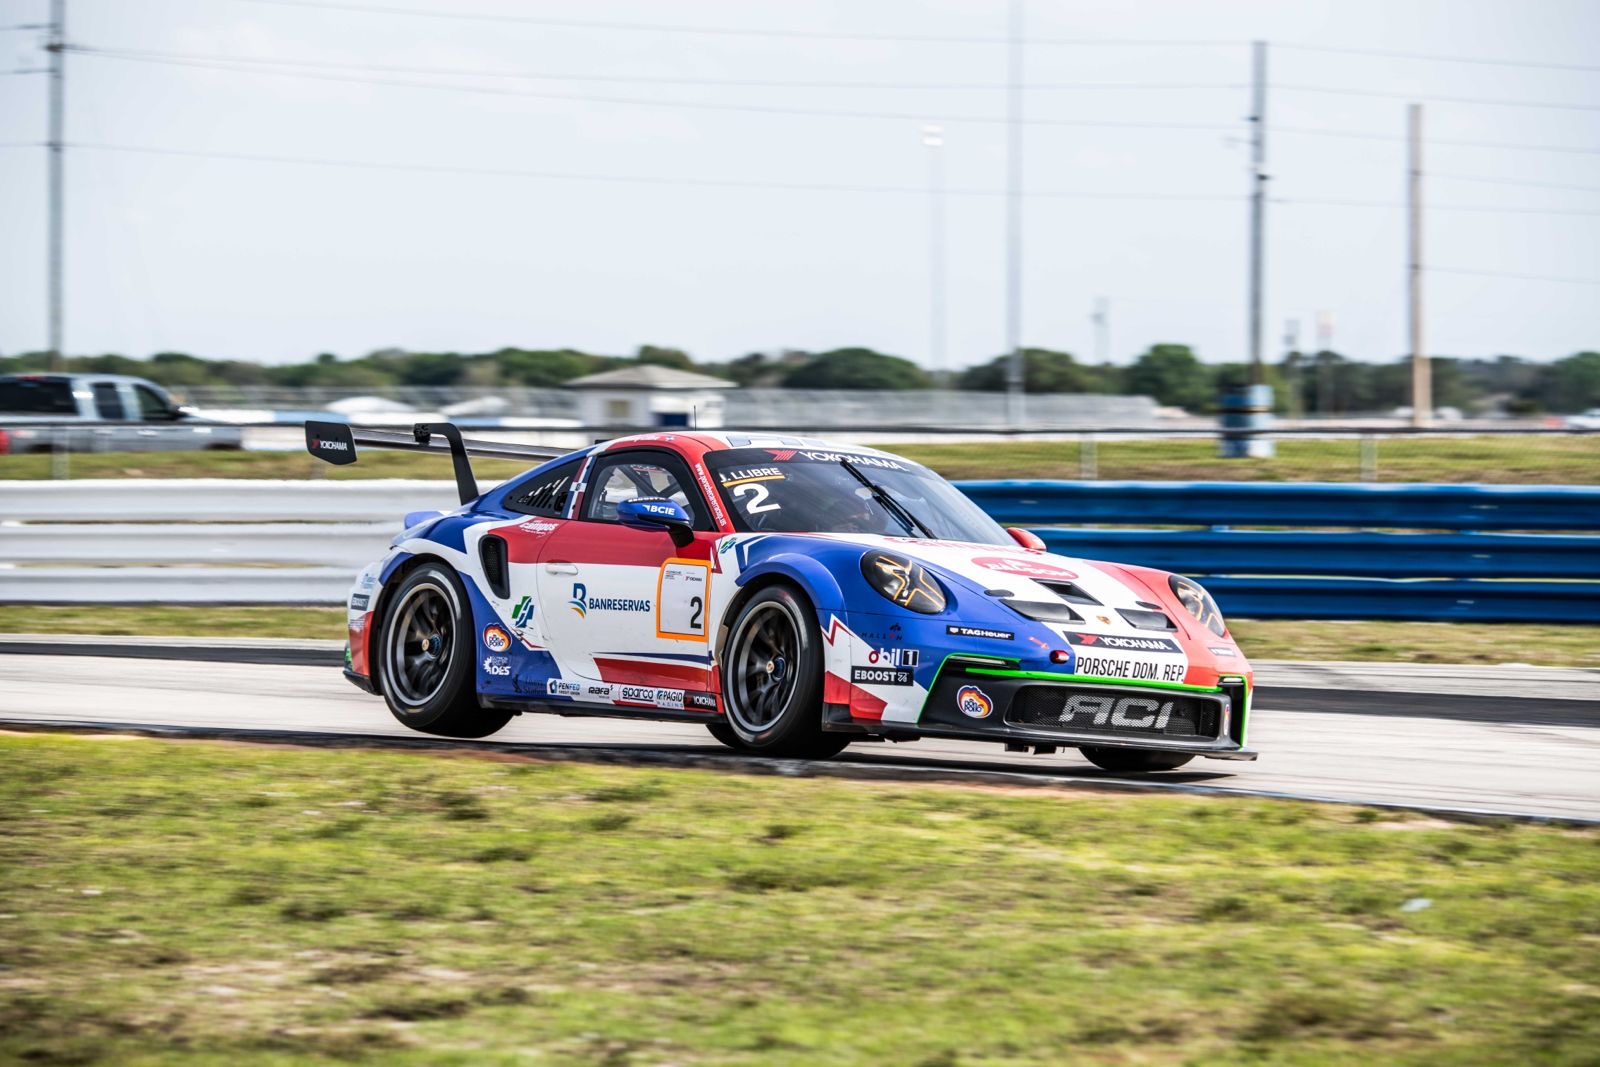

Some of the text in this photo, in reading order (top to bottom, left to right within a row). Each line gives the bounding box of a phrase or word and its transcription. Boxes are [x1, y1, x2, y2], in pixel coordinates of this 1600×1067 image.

[320, 440, 348, 451] YOKOHAMA
[798, 451, 911, 473] YOKOHAMA
[719, 467, 783, 483] J. LLIBRE
[733, 483, 781, 515] 2
[650, 505, 676, 516] BCIE
[589, 598, 651, 613] BANRESERVAS
[690, 596, 703, 629] 2
[1098, 636, 1173, 650] YOKOHAMA
[854, 670, 897, 682] EBOOST
[1075, 656, 1185, 682] PORSCHE DOM. REP.
[558, 682, 580, 691] PENFED
[622, 687, 654, 699] sparco
[663, 691, 683, 702] PAGID
